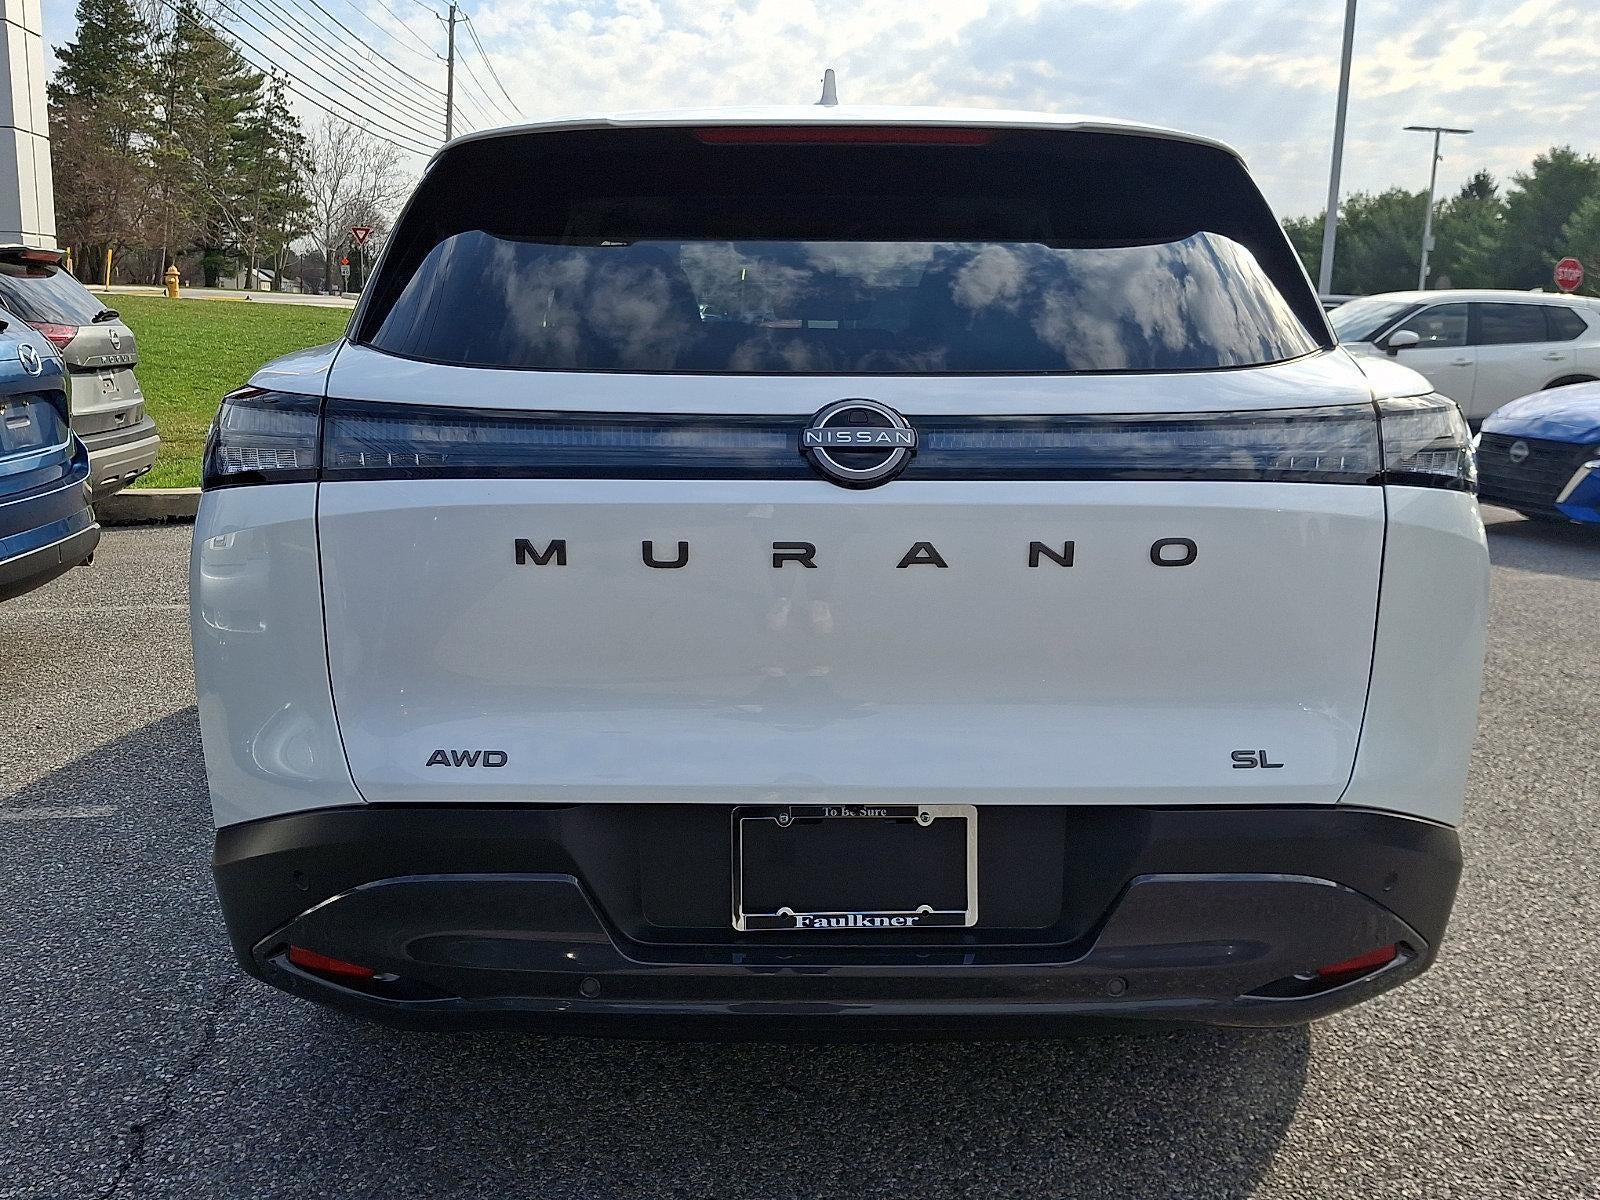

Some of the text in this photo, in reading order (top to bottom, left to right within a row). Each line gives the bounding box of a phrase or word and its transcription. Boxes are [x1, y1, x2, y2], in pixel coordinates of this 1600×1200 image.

[806, 431, 911, 444] NISSAN
[514, 537, 1199, 569] MURANO
[425, 749, 508, 768] AWD
[1231, 749, 1285, 769] SL
[822, 806, 838, 817] To
[859, 805, 888, 817] Sure
[794, 914, 920, 928] Faulkner
